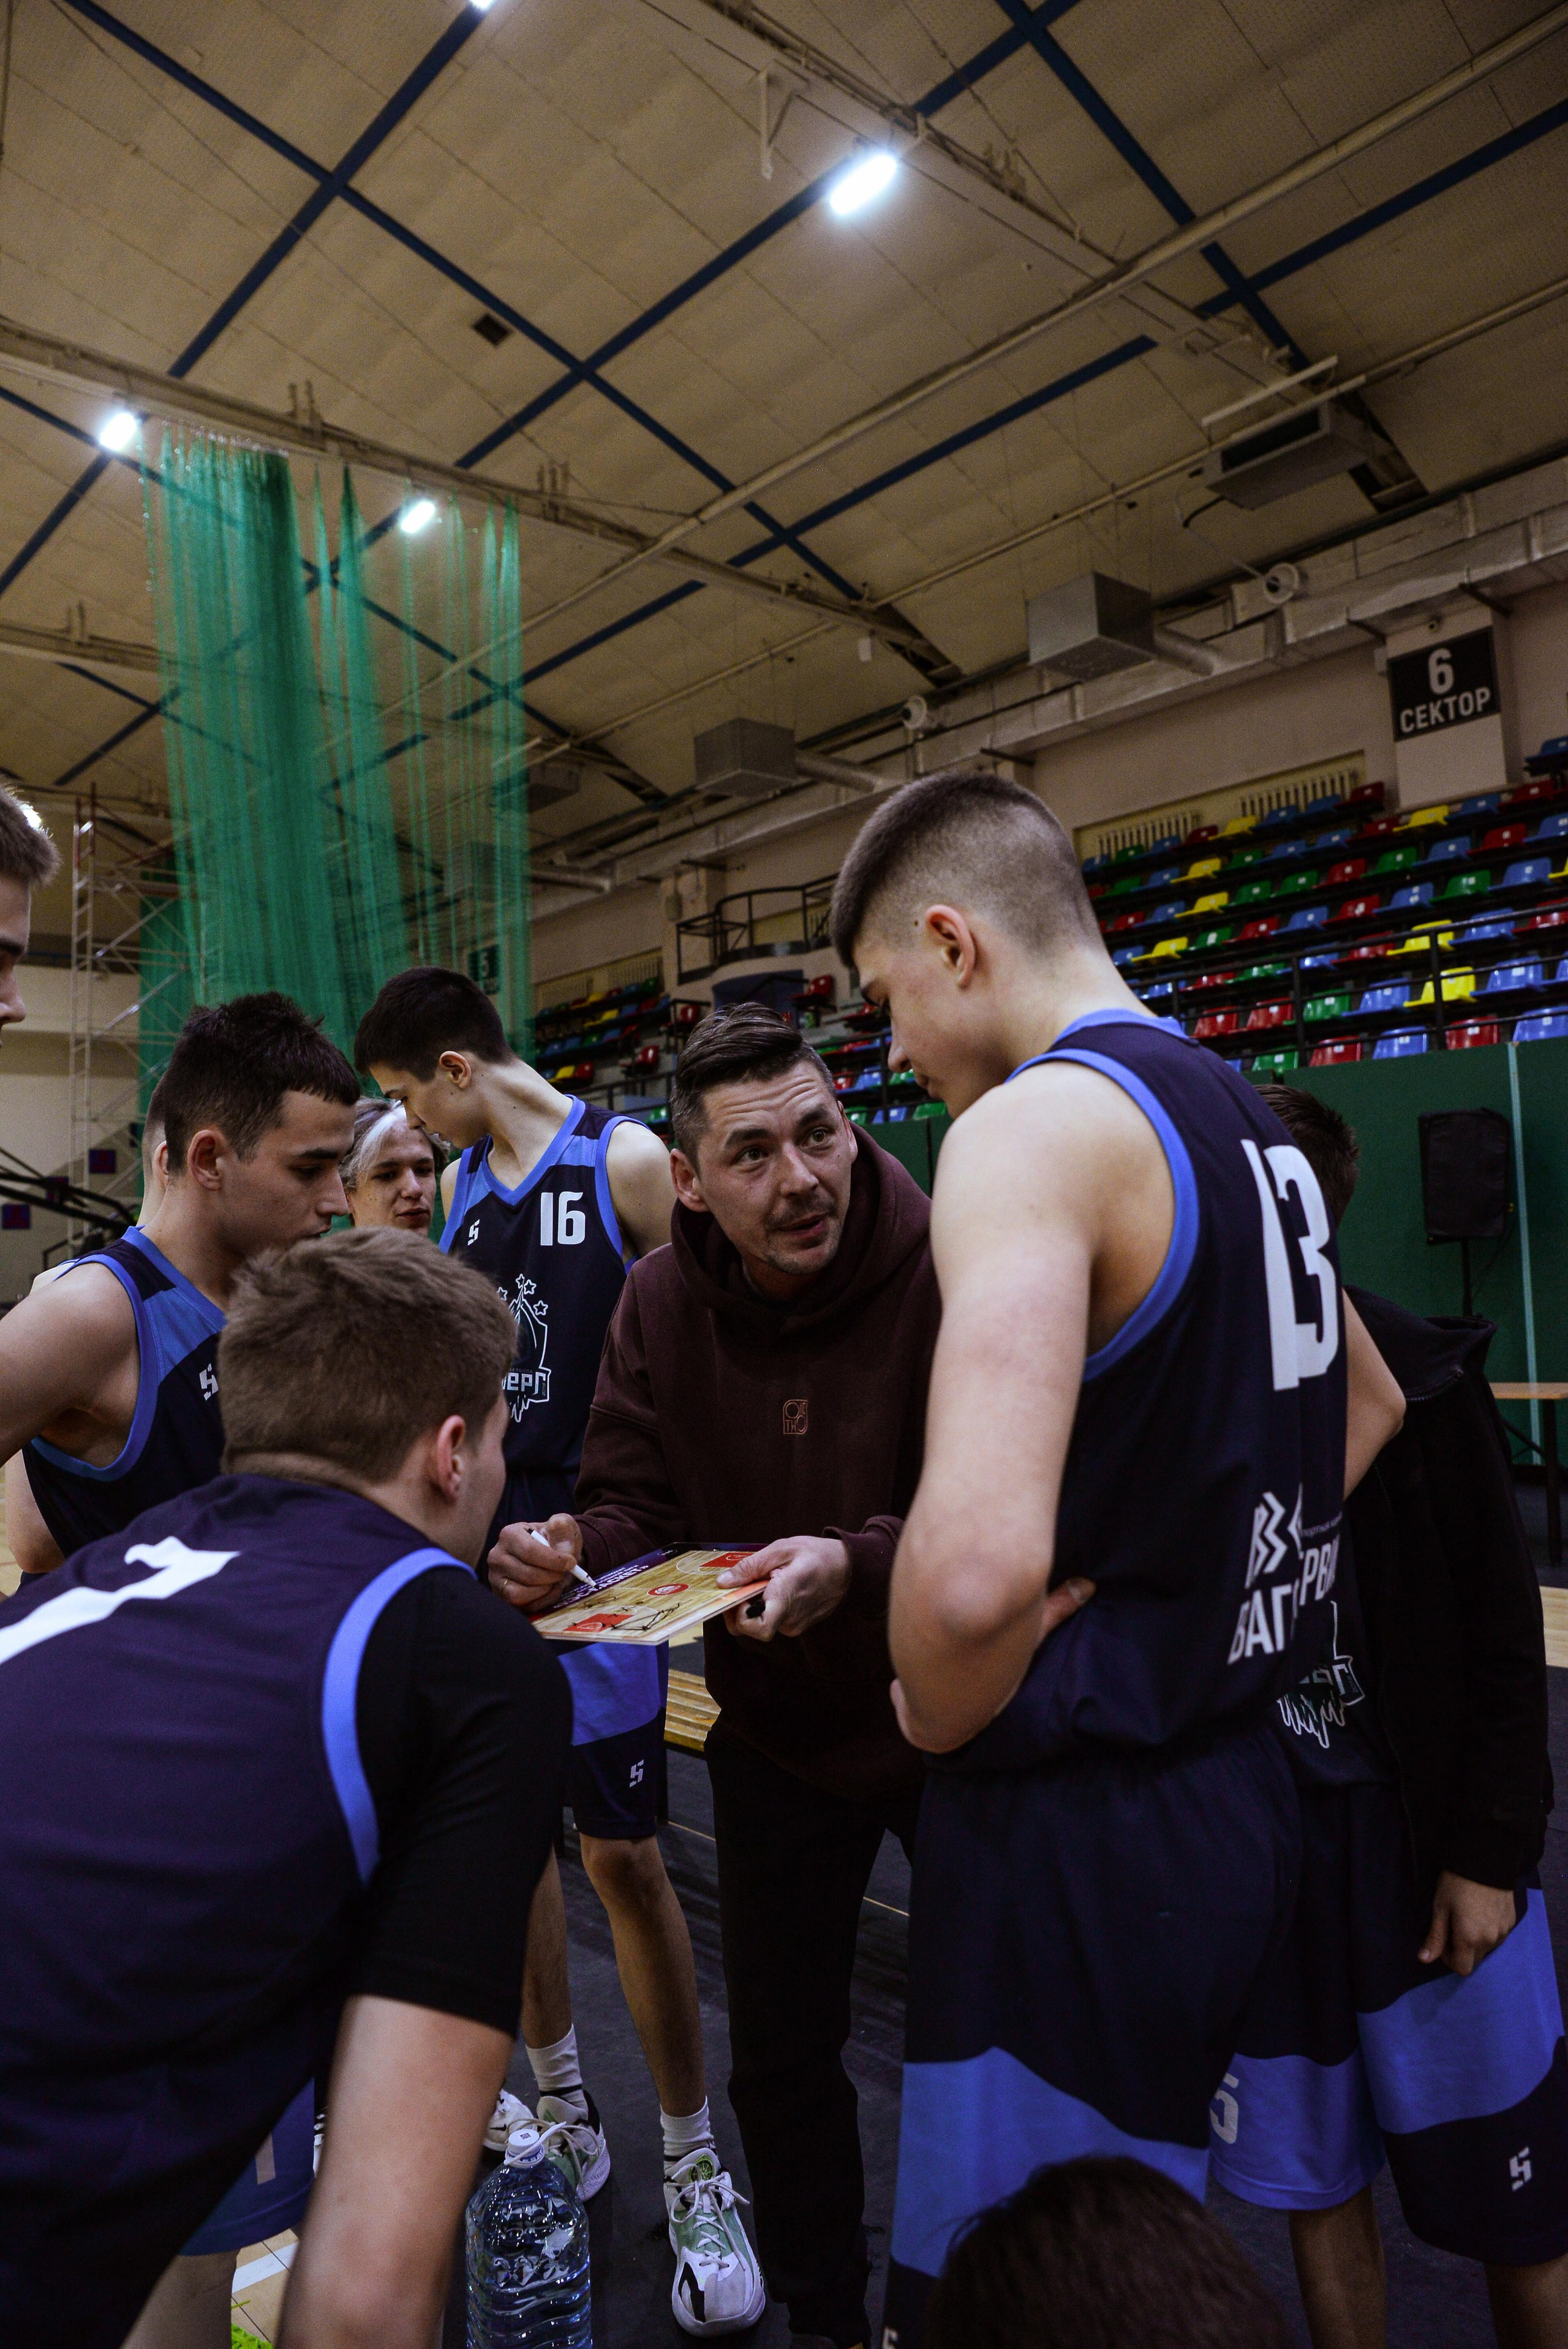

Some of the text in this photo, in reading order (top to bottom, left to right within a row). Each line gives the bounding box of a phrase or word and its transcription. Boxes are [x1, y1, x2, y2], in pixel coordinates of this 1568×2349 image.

[1428, 647, 1454, 695] 6
[1400, 687, 1491, 734] СЕКТОР
[540, 1191, 586, 1246] 16
[1240, 1139, 1339, 1392] 13
